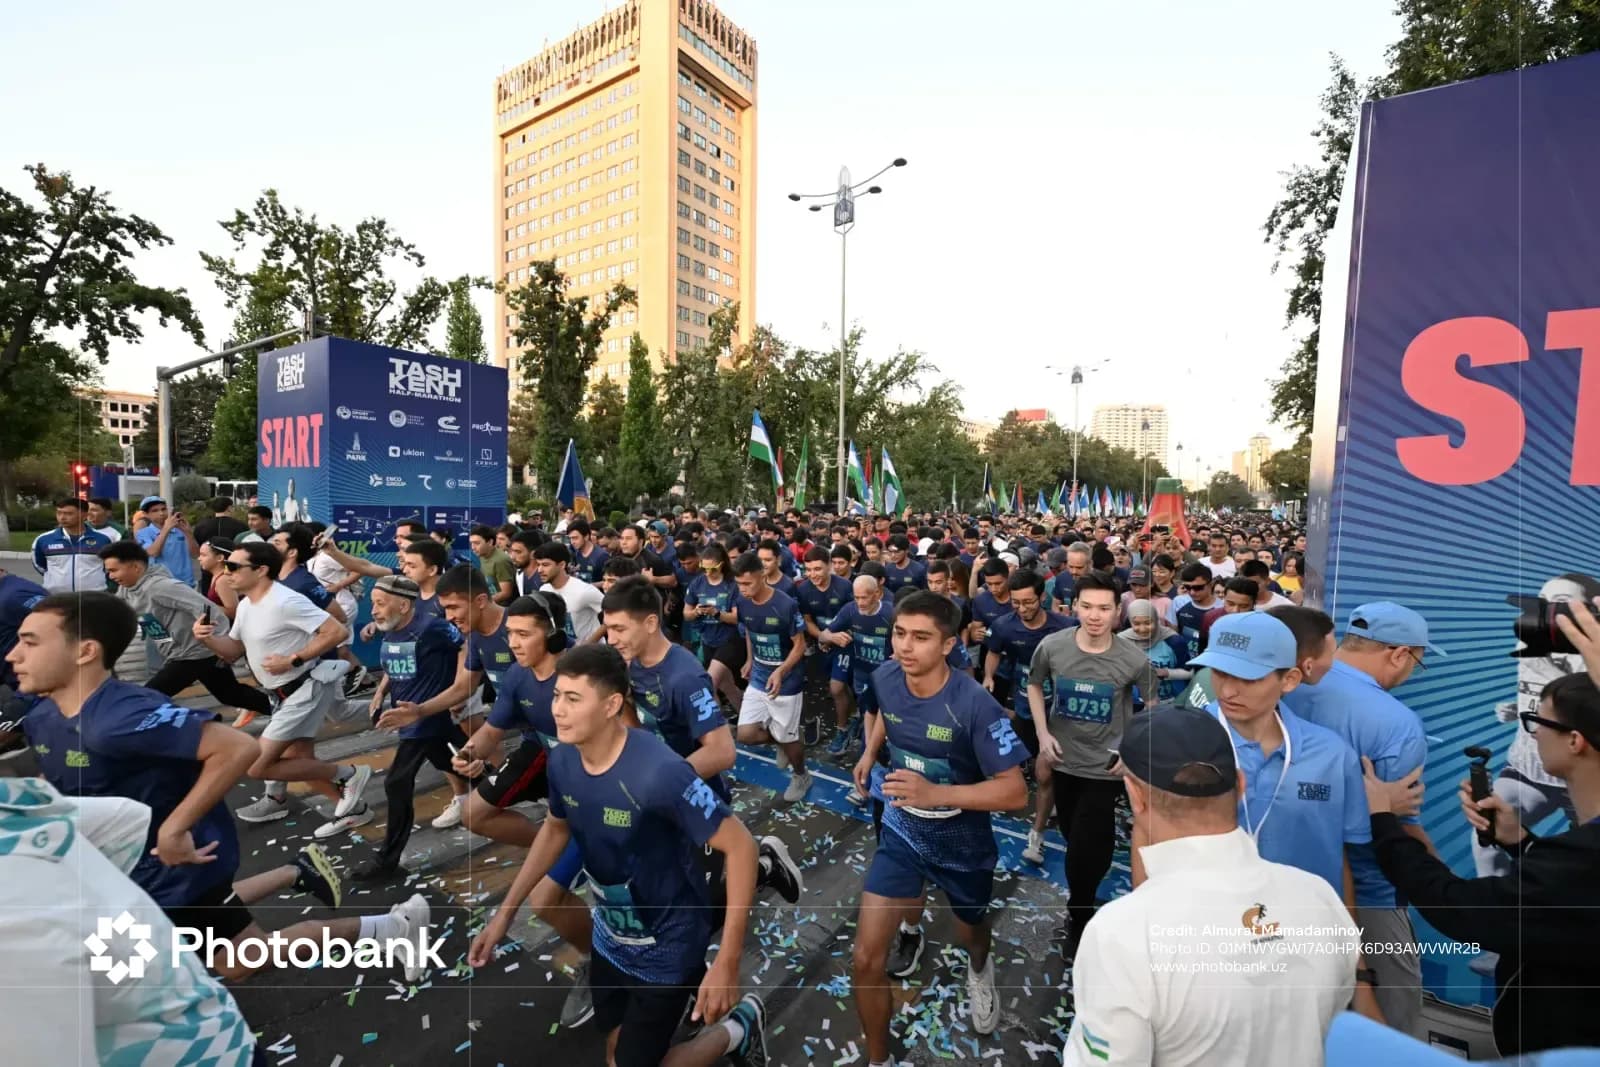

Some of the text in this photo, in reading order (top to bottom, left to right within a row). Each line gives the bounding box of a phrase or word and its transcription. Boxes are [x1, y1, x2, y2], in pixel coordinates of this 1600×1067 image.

[277, 352, 304, 374] TASH
[389, 358, 461, 388] TASH
[277, 369, 304, 389] KENT
[389, 373, 457, 397] KENT
[261, 413, 324, 469] START
[402, 449, 425, 457] uklon
[386, 658, 416, 674] 2825
[838, 654, 850, 667] 14
[1067, 697, 1111, 717] 8739
